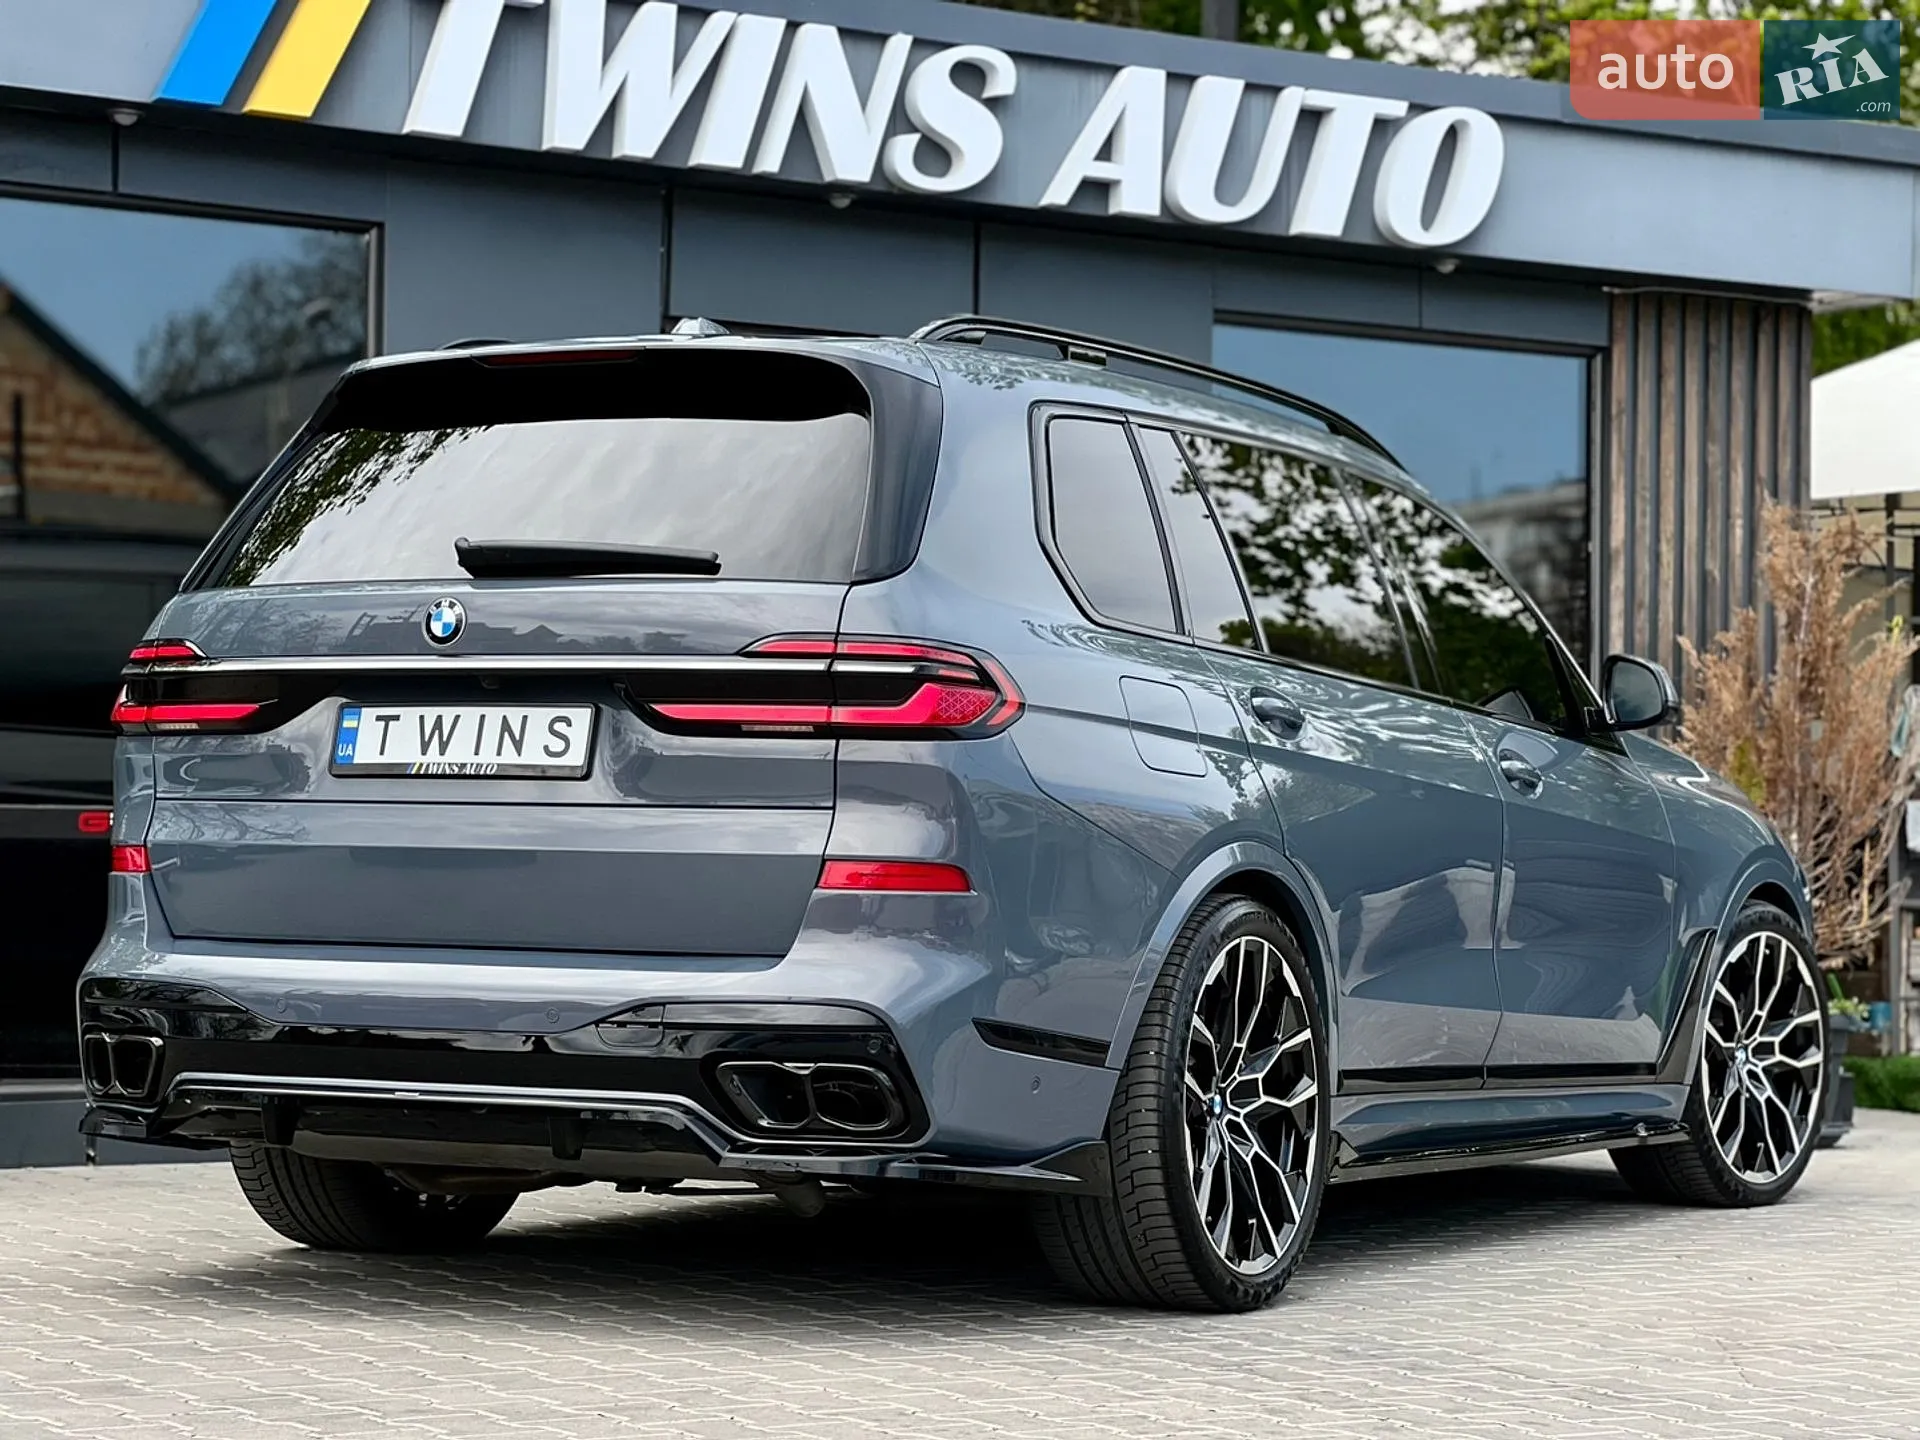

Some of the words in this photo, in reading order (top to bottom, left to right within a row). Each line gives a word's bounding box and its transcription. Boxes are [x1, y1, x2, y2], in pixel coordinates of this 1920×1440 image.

[401, 0, 1017, 194] TWINS
[1039, 66, 1504, 247] AUTO
[337, 743, 354, 757] UA
[374, 714, 573, 758] TWINS
[419, 762, 461, 775] TWINS
[460, 762, 498, 775] AUTO
